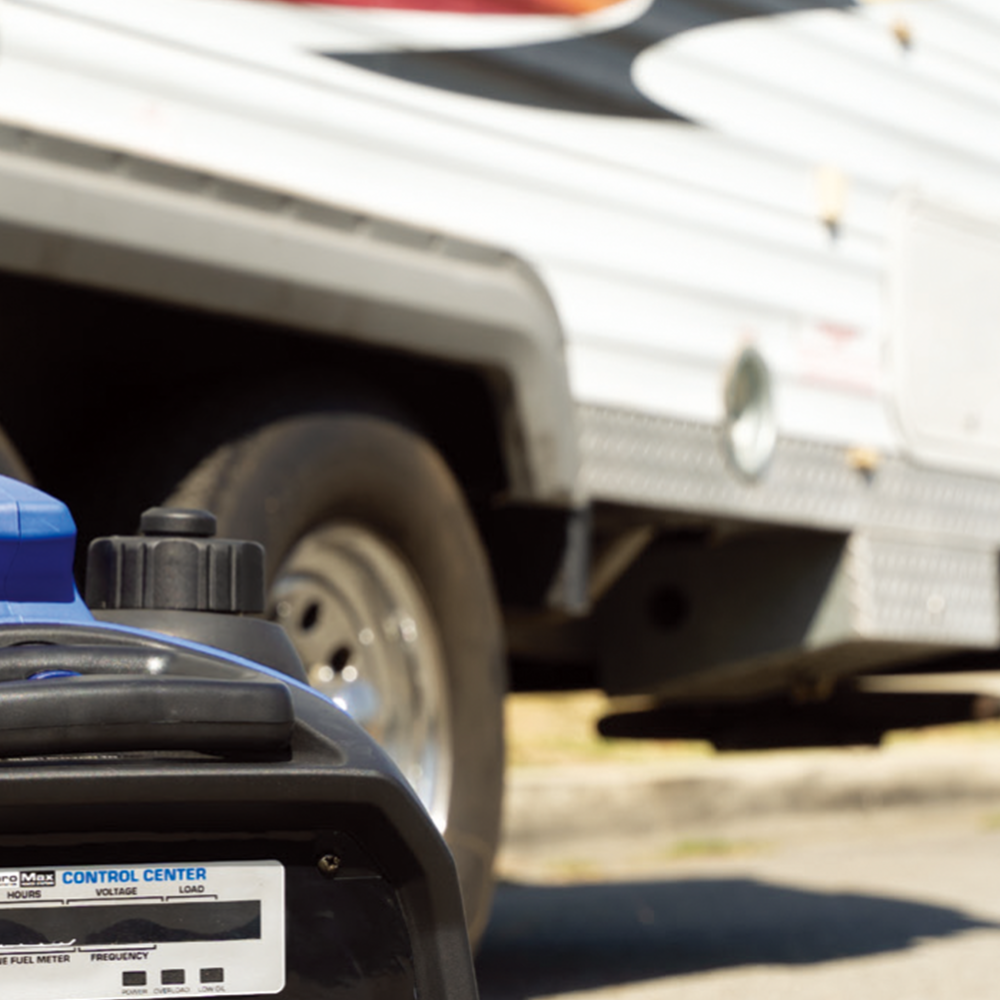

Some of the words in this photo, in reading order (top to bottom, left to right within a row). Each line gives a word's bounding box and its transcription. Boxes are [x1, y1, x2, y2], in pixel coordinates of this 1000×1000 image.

[21, 872, 54, 882] Max
[62, 869, 139, 884] CONTROL
[143, 867, 206, 882] CENTER
[7, 889, 41, 899] HOURS
[95, 887, 137, 896] VOLTAGE
[179, 885, 205, 894] LOAD
[10, 956, 34, 964] FUEL
[36, 954, 71, 963] METER
[90, 952, 149, 961] FREQUENCY
